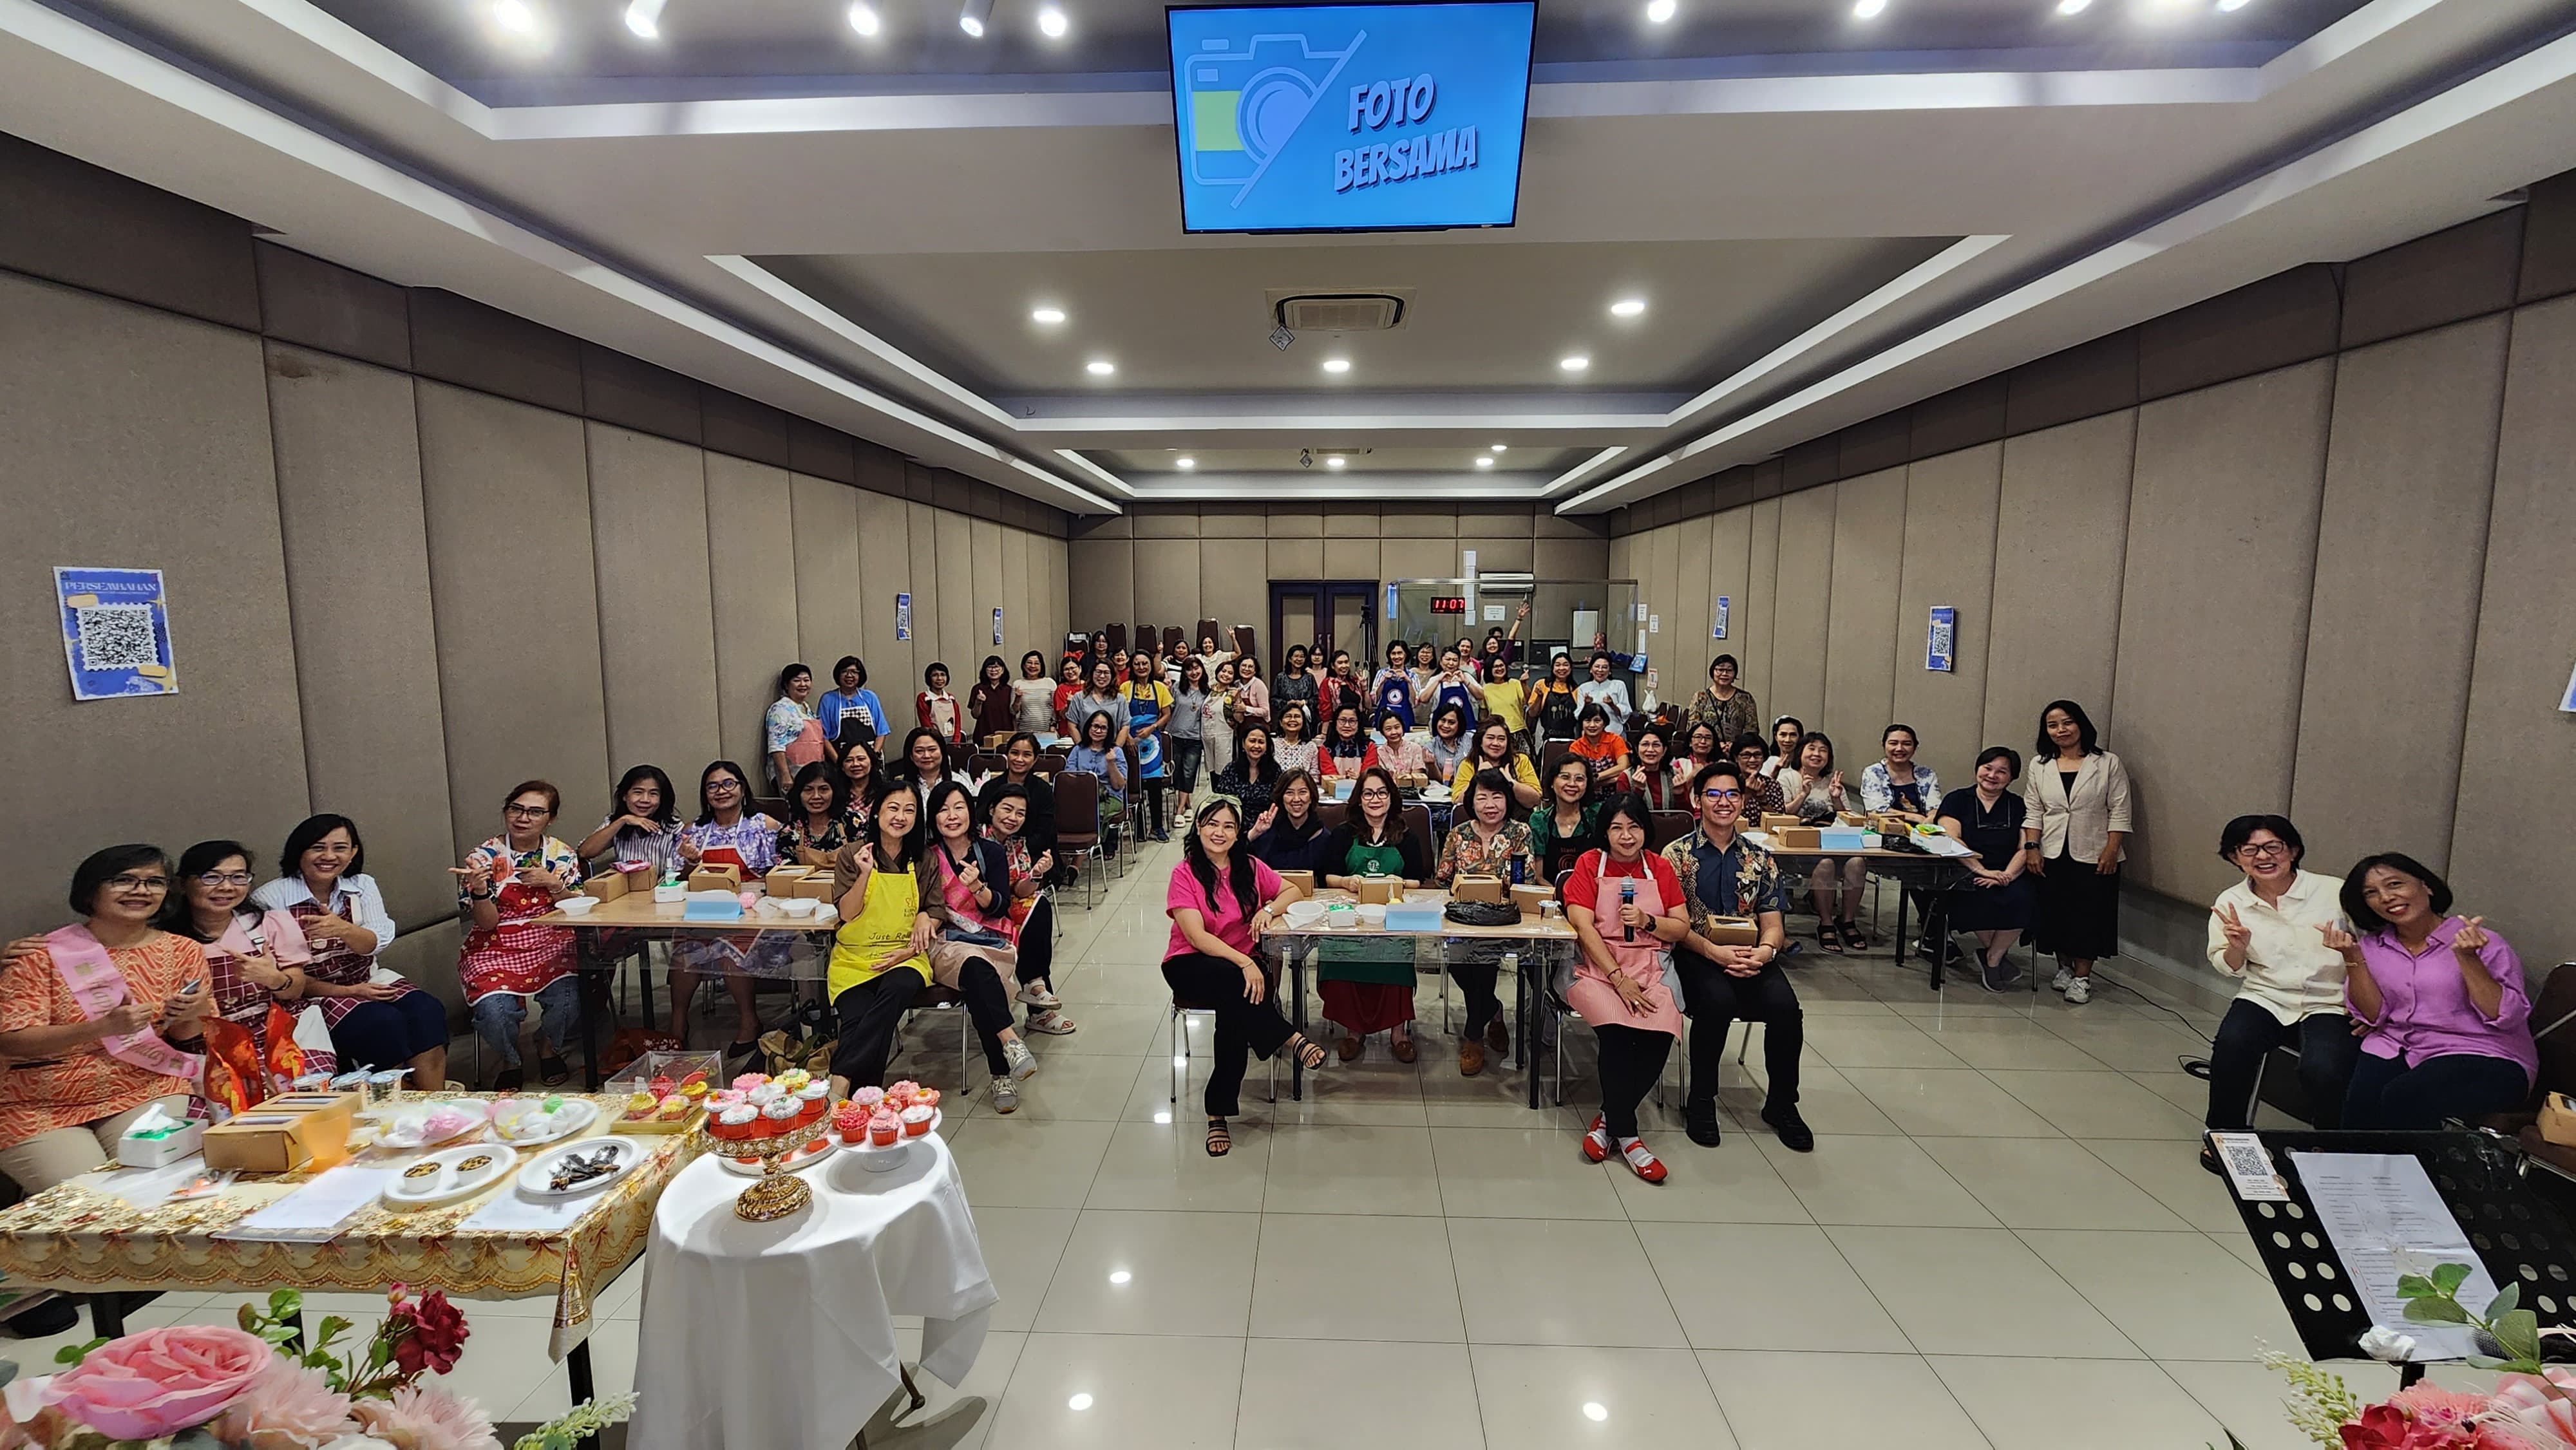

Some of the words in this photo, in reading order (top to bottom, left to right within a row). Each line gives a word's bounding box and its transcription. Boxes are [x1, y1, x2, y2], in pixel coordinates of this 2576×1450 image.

[1348, 73, 1435, 133] FOTO
[1334, 125, 1477, 194] BERSAMA
[65, 581, 156, 591] PERSEMBAHAN
